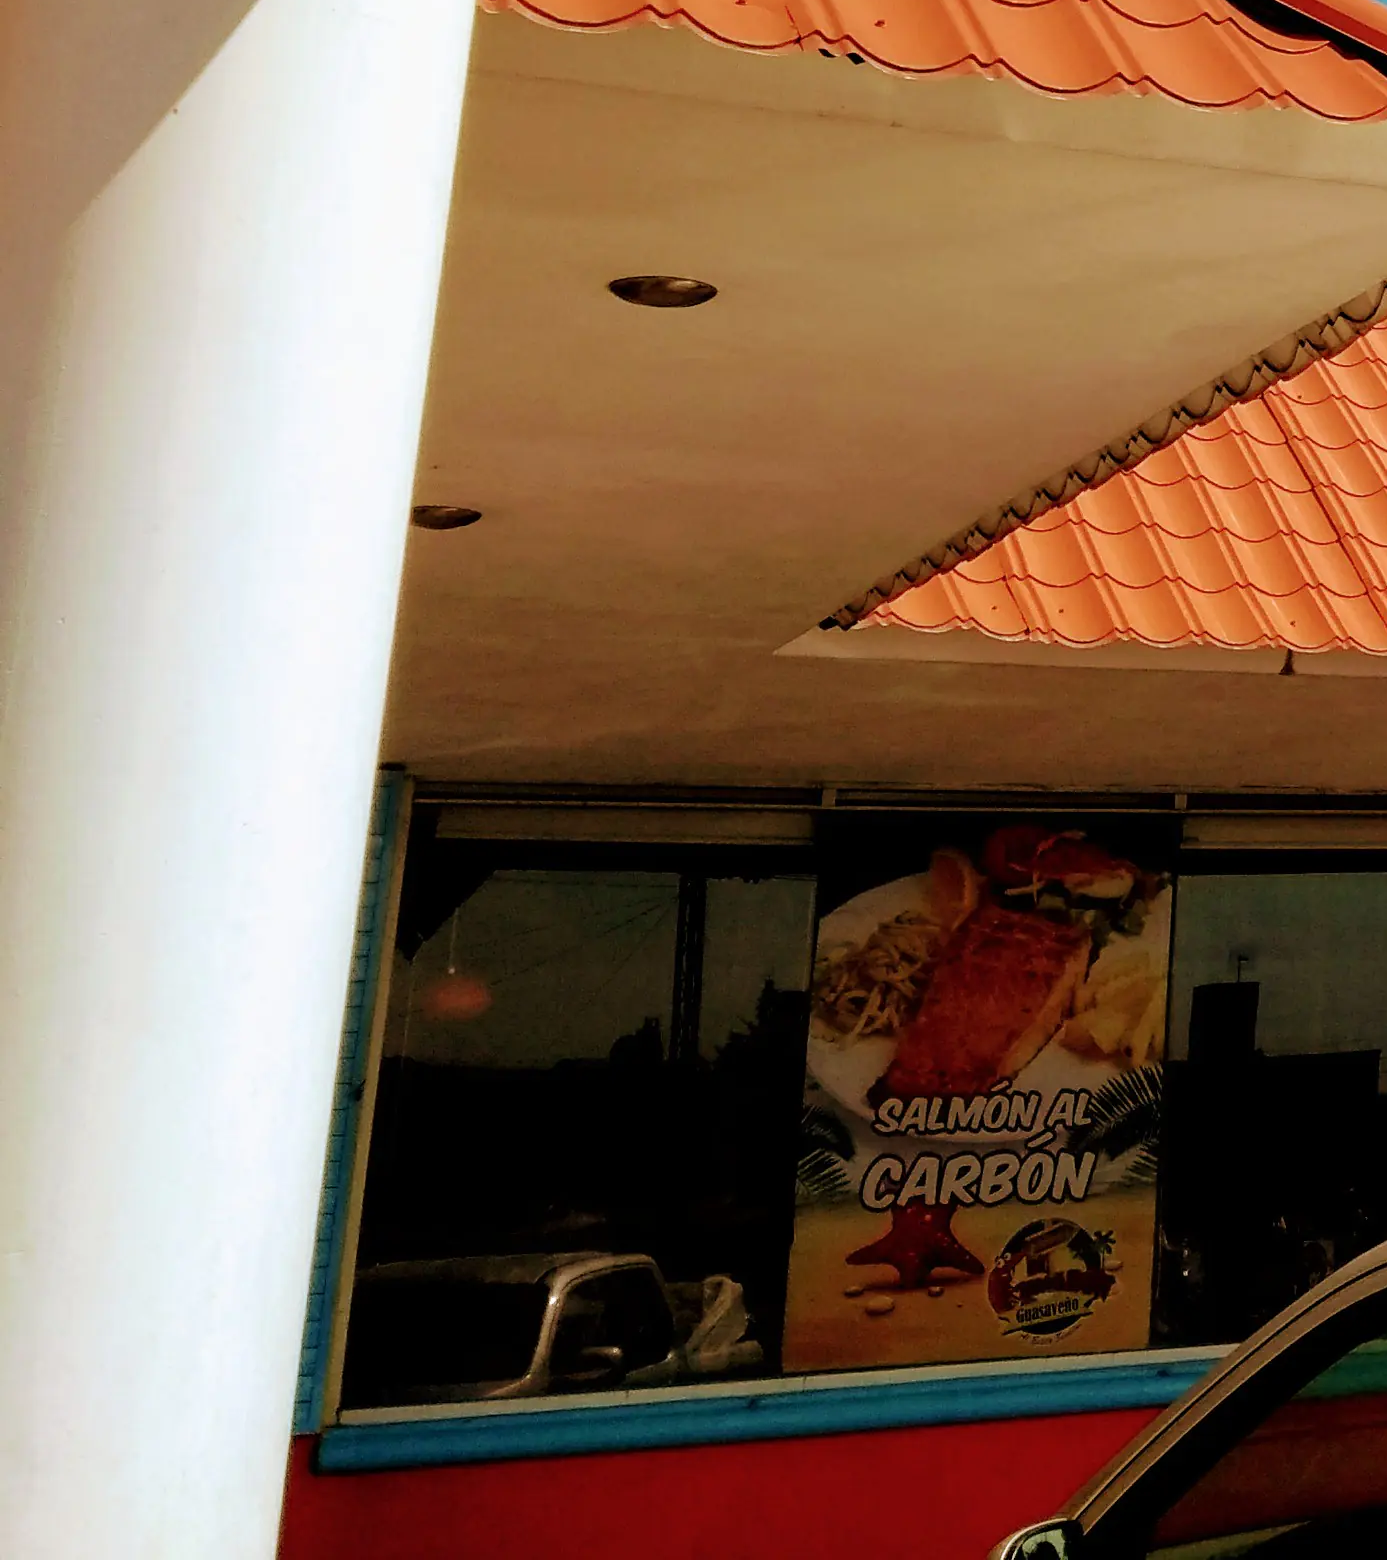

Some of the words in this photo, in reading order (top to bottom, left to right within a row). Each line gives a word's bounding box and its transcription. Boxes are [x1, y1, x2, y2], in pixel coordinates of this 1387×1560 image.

[872, 1080, 1038, 1136] SALMÓN
[1046, 1088, 1094, 1130] AL
[862, 1131, 1098, 1210] CARBÓN
